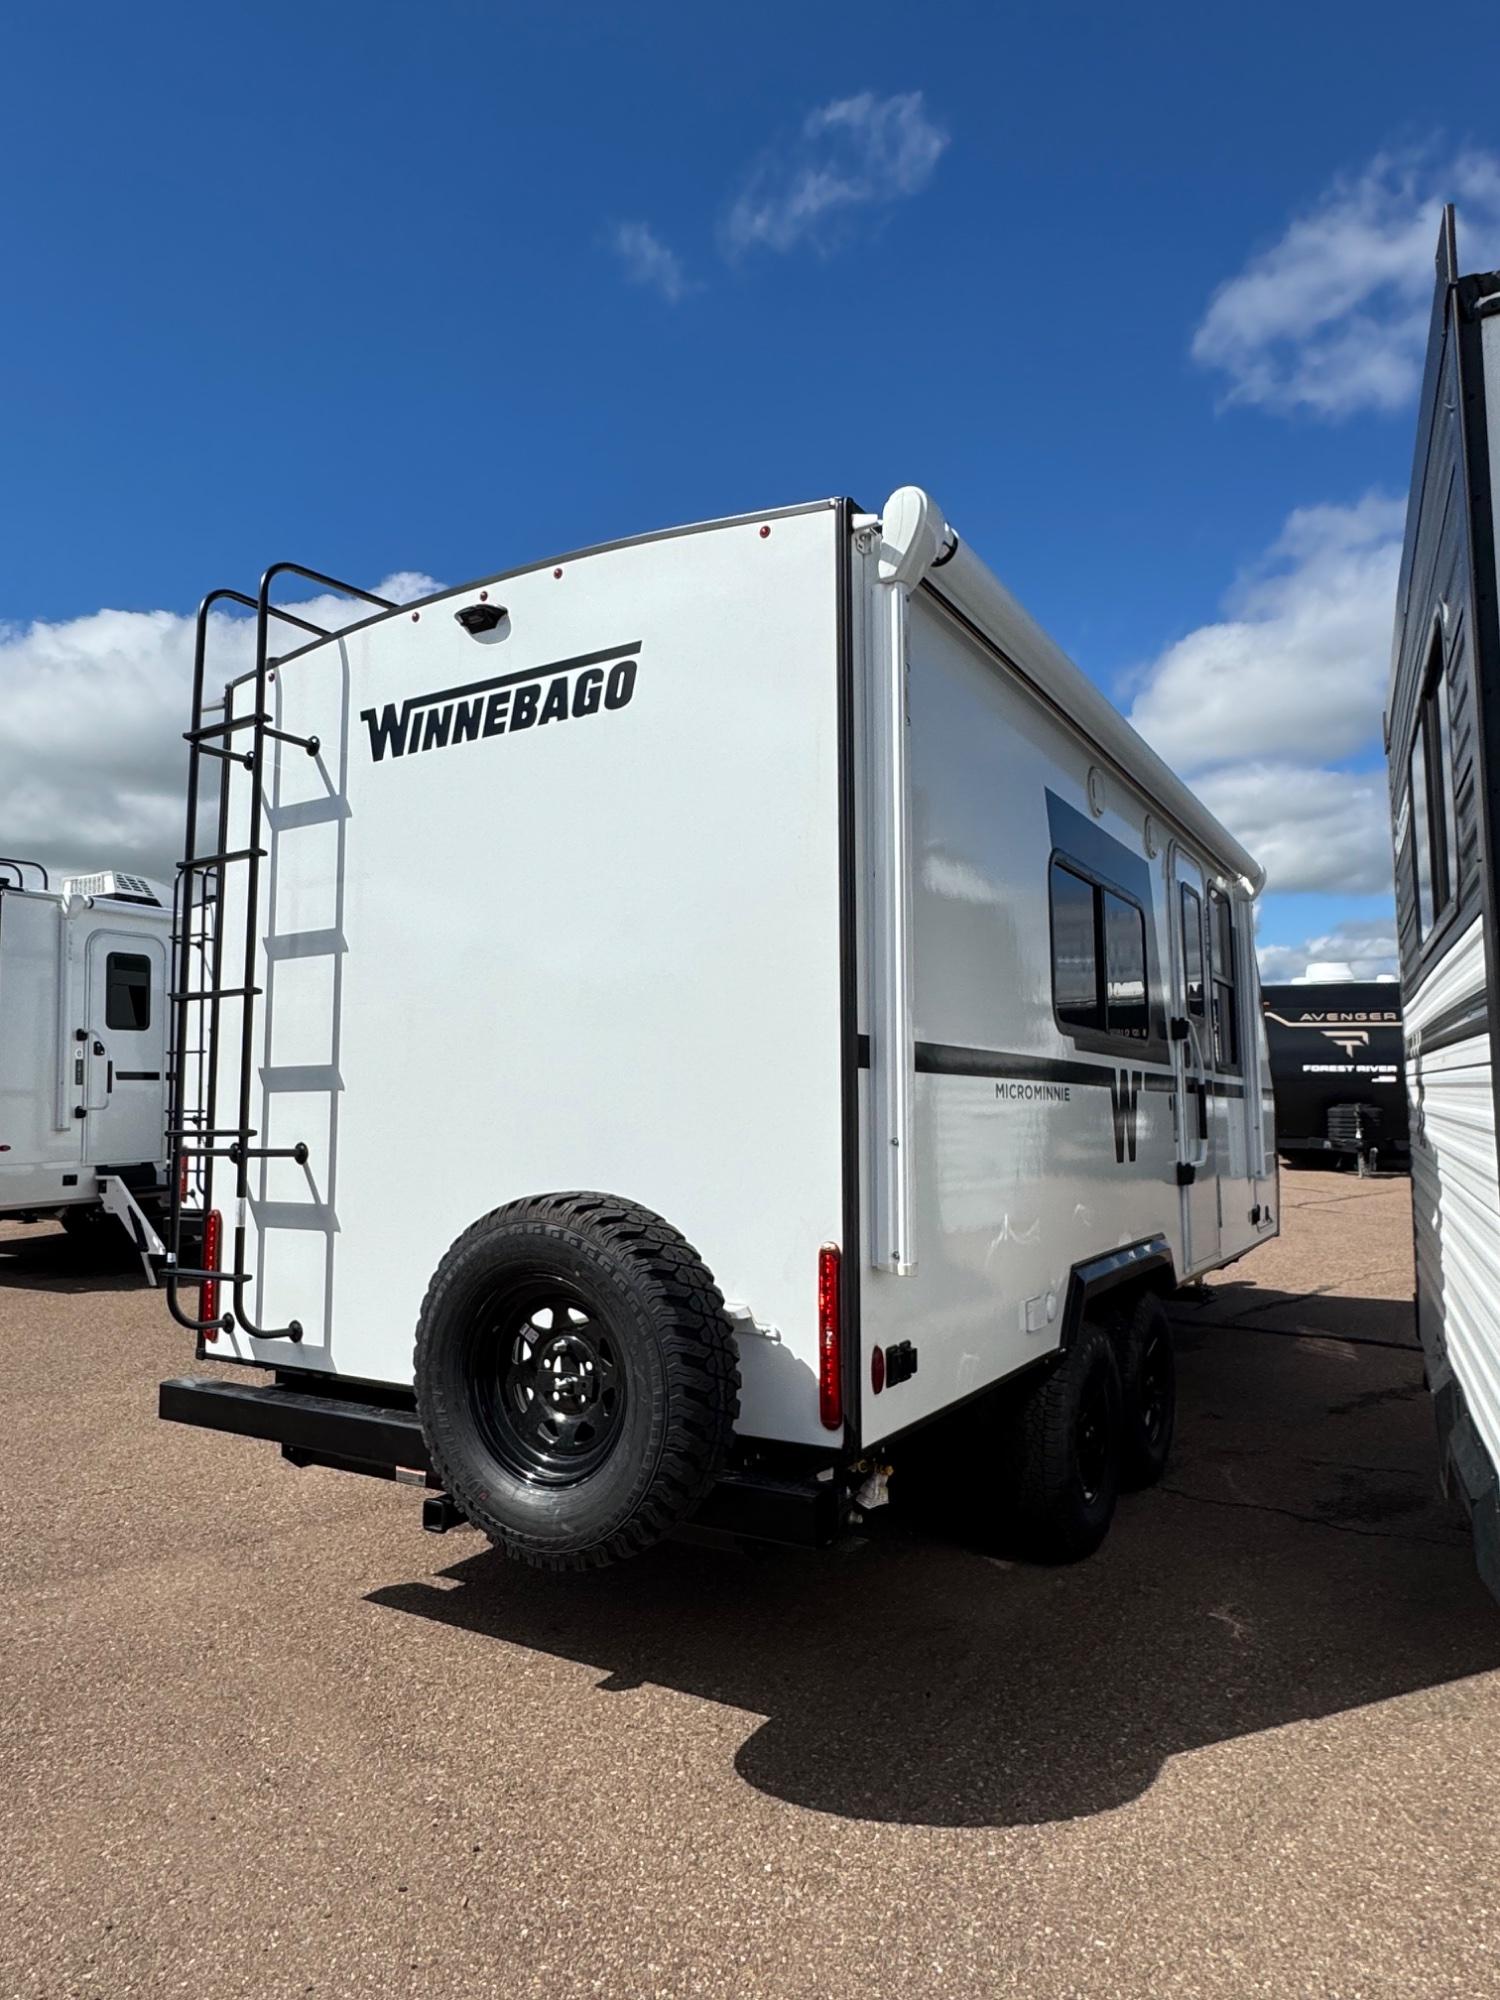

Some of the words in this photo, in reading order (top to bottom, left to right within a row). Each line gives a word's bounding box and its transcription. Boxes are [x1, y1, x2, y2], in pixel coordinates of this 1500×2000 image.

[360, 641, 642, 762] WINNEBAGO
[1300, 1012, 1397, 1021] AVENGER
[1302, 1064, 1354, 1073] FOREST
[1356, 1064, 1398, 1073] RIVER
[995, 1083, 1071, 1102] MICROMINNIE
